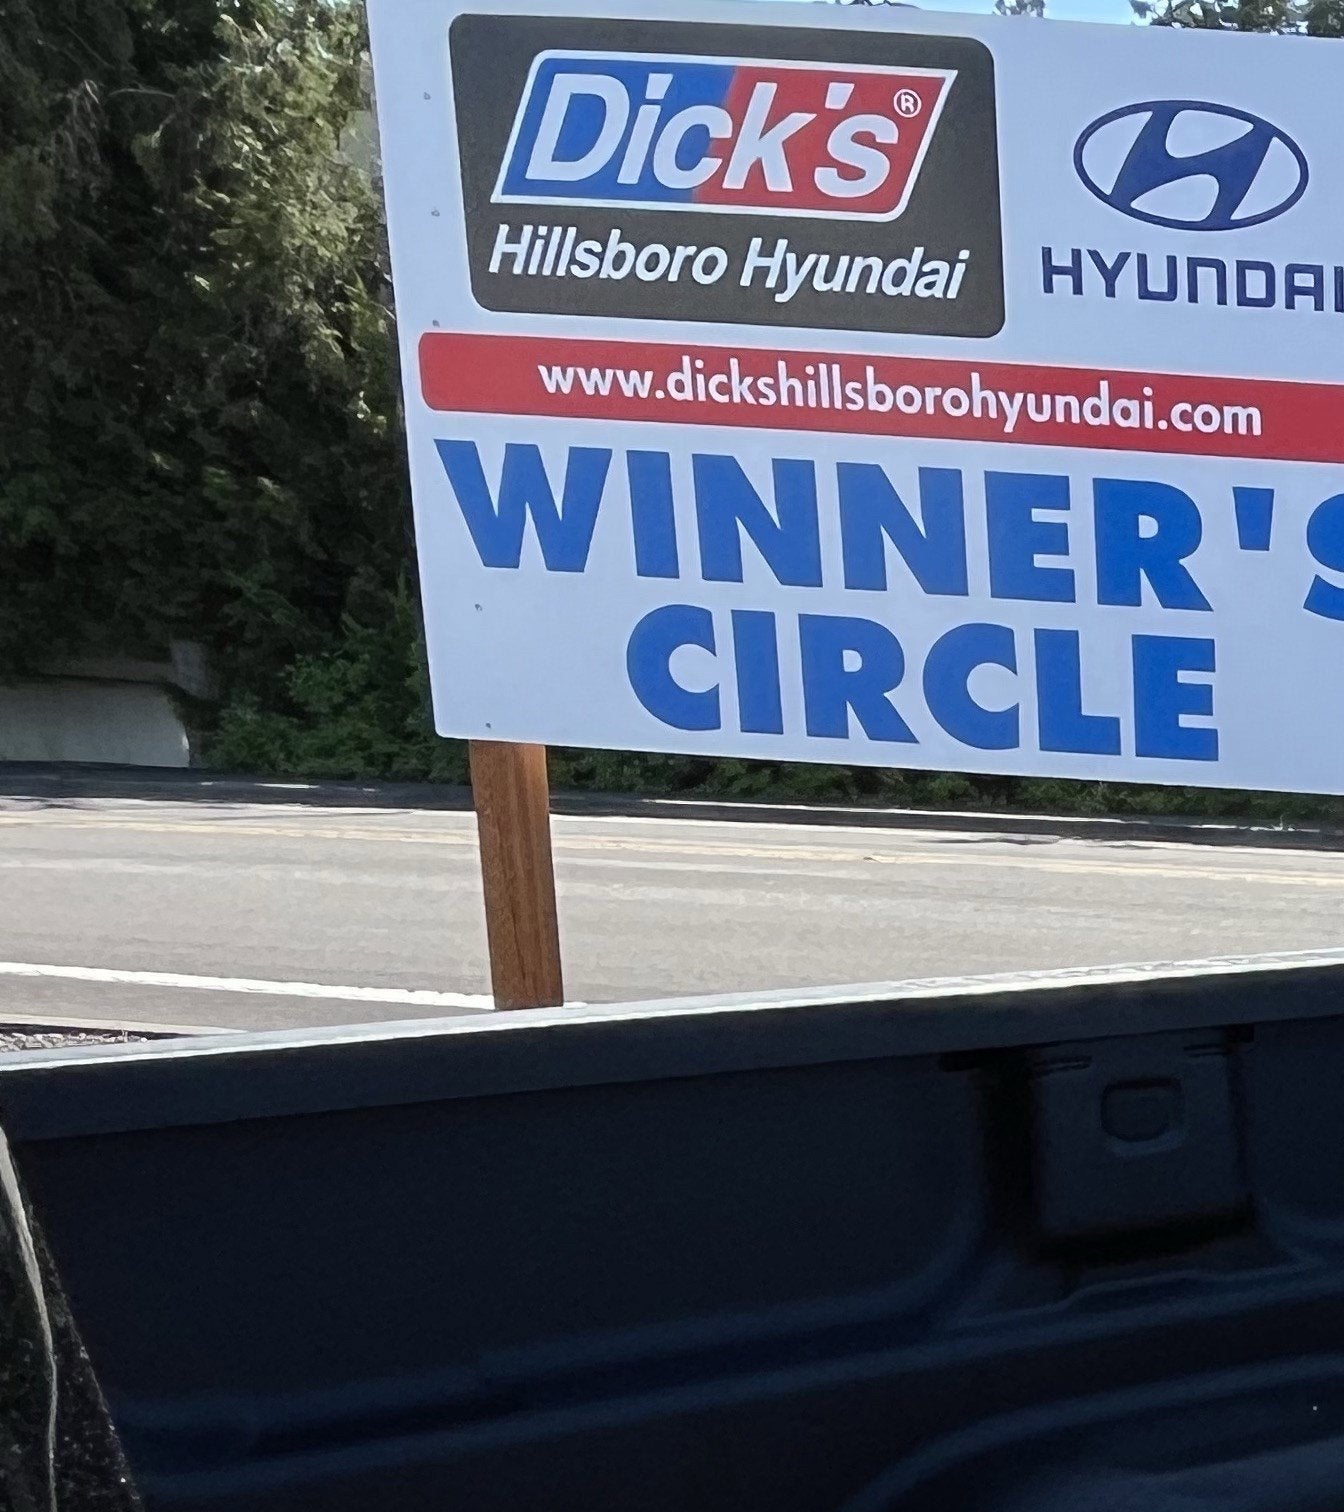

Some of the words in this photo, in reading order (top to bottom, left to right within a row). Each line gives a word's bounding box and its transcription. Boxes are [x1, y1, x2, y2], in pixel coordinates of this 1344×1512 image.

[488, 223, 728, 284] Hillsboro
[740, 236, 971, 302] Hyundai
[1041, 246, 1344, 314] HYUNDAI
[537, 355, 1263, 437] www.dickshillsborohyundai.com
[626, 604, 1219, 762] CIRCLE
